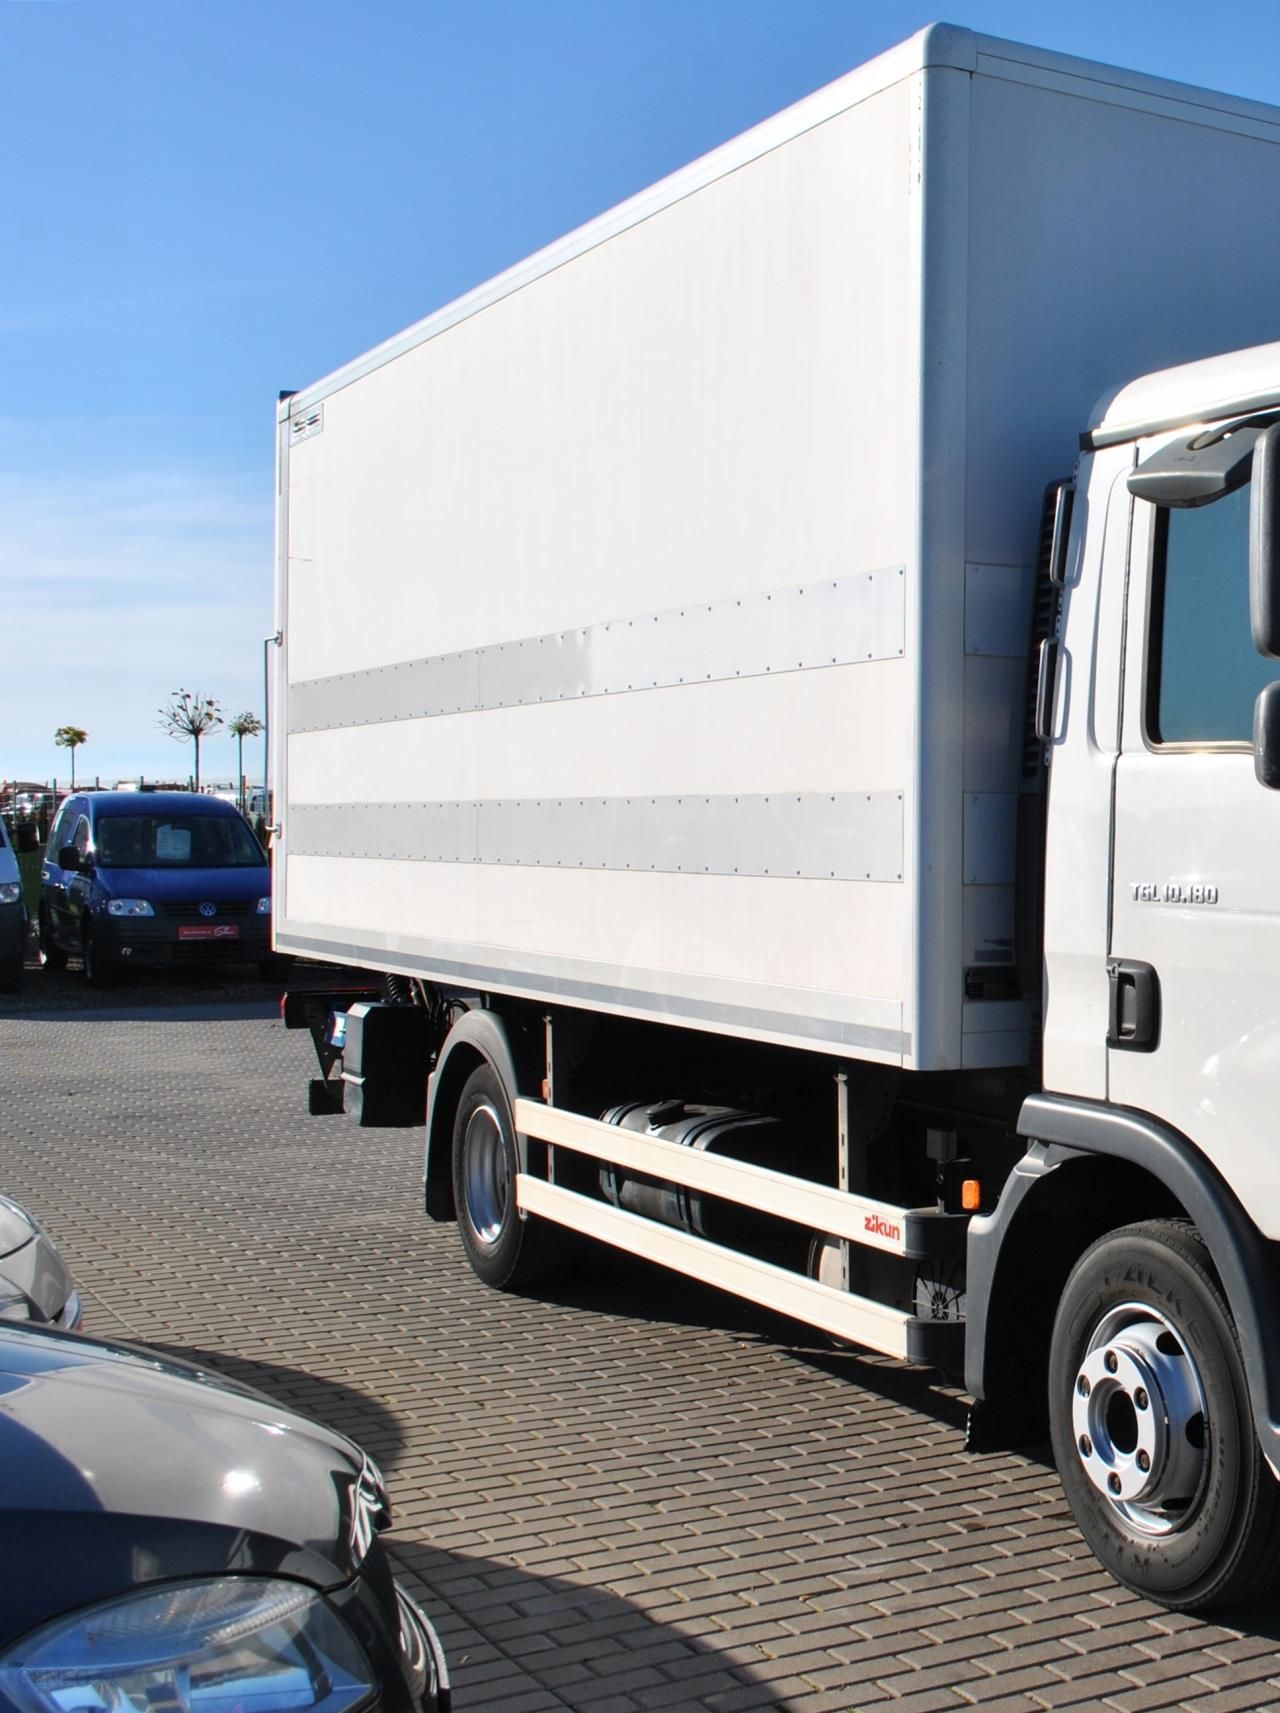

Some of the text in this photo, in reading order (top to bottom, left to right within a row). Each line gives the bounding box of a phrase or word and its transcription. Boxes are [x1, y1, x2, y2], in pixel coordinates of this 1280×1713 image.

[1129, 882, 1218, 905] TGL 10.180
[863, 1214, 900, 1240] zikun
